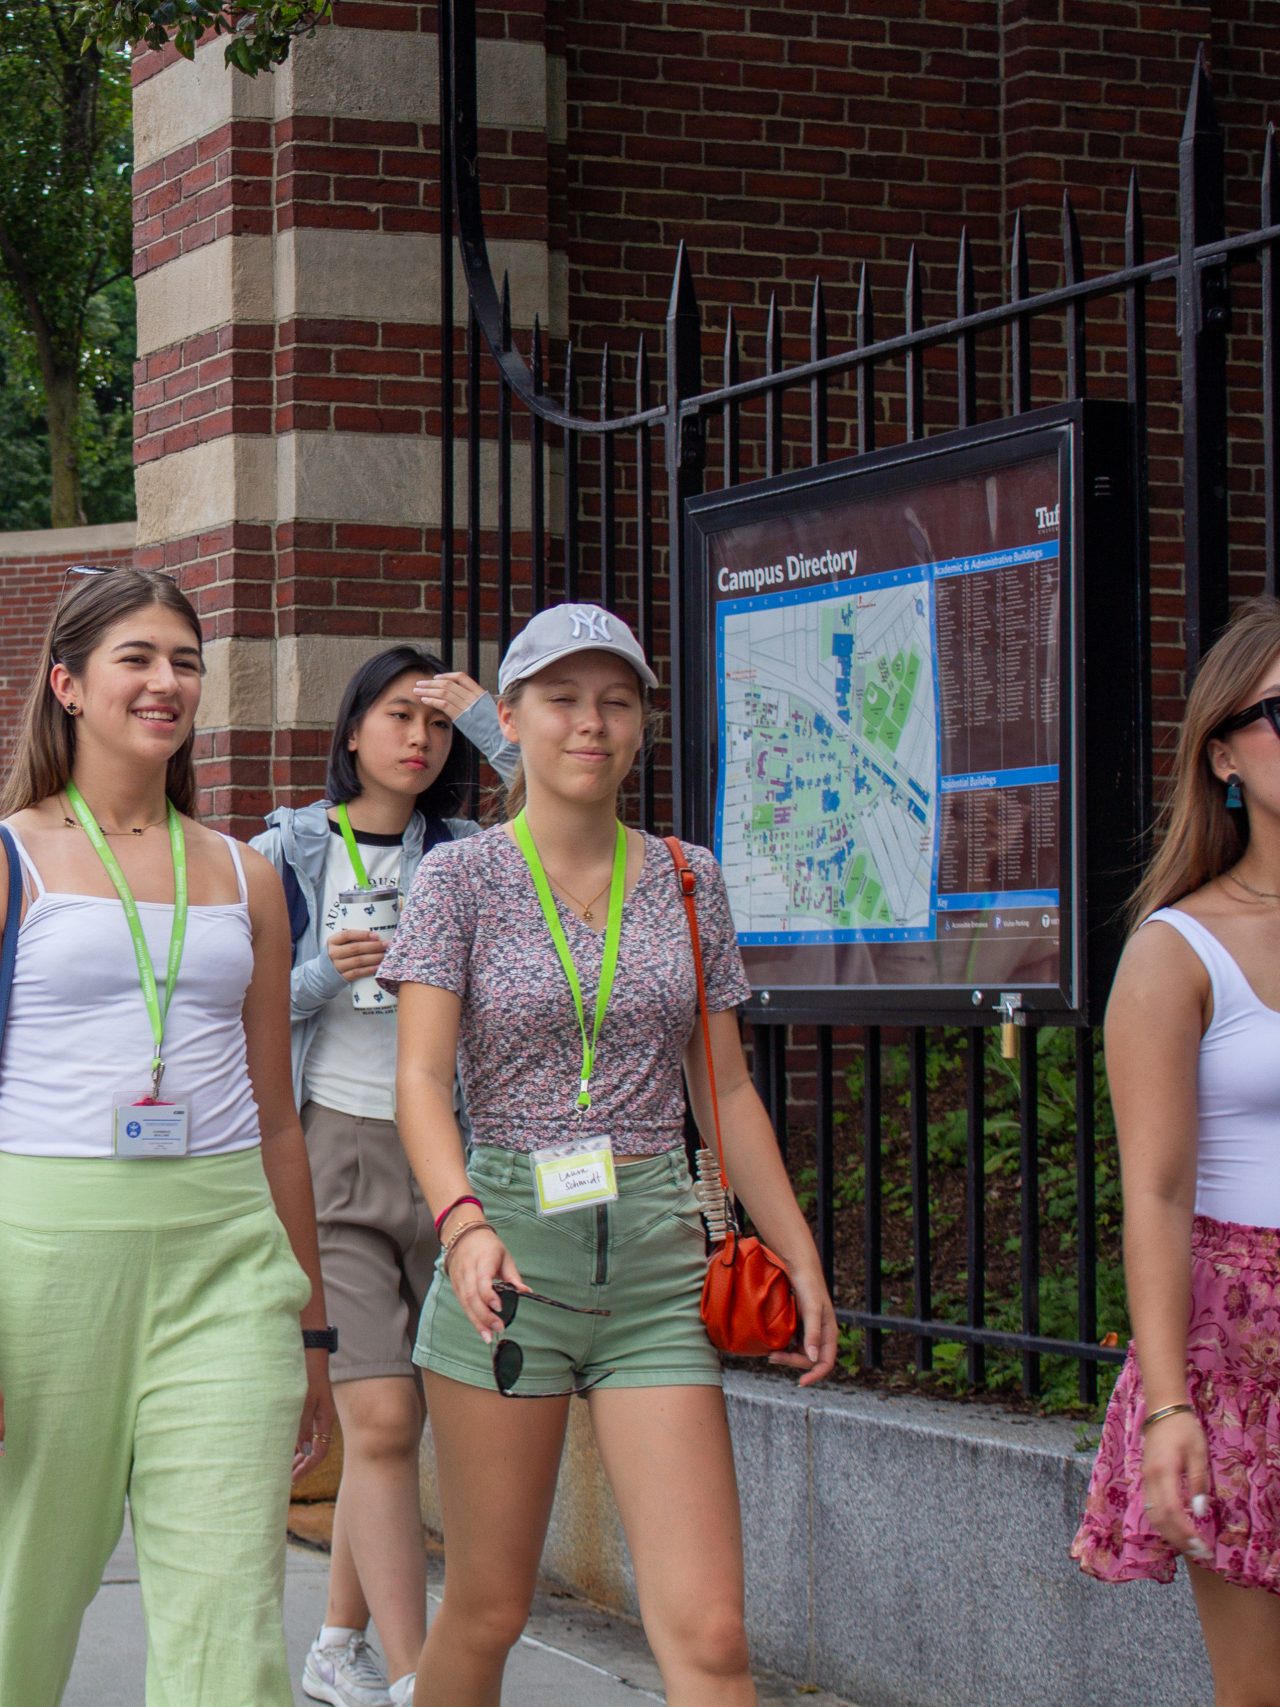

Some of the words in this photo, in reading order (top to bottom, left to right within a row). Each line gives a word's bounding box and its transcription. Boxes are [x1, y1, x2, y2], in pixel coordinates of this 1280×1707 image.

[717, 564, 785, 592] Campus
[786, 549, 857, 576] Directory
[963, 560, 970, 571] &
[1013, 549, 1043, 562] Buildings
[570, 608, 613, 642] NY
[969, 774, 997, 787] Buildings
[937, 898, 948, 909] Key
